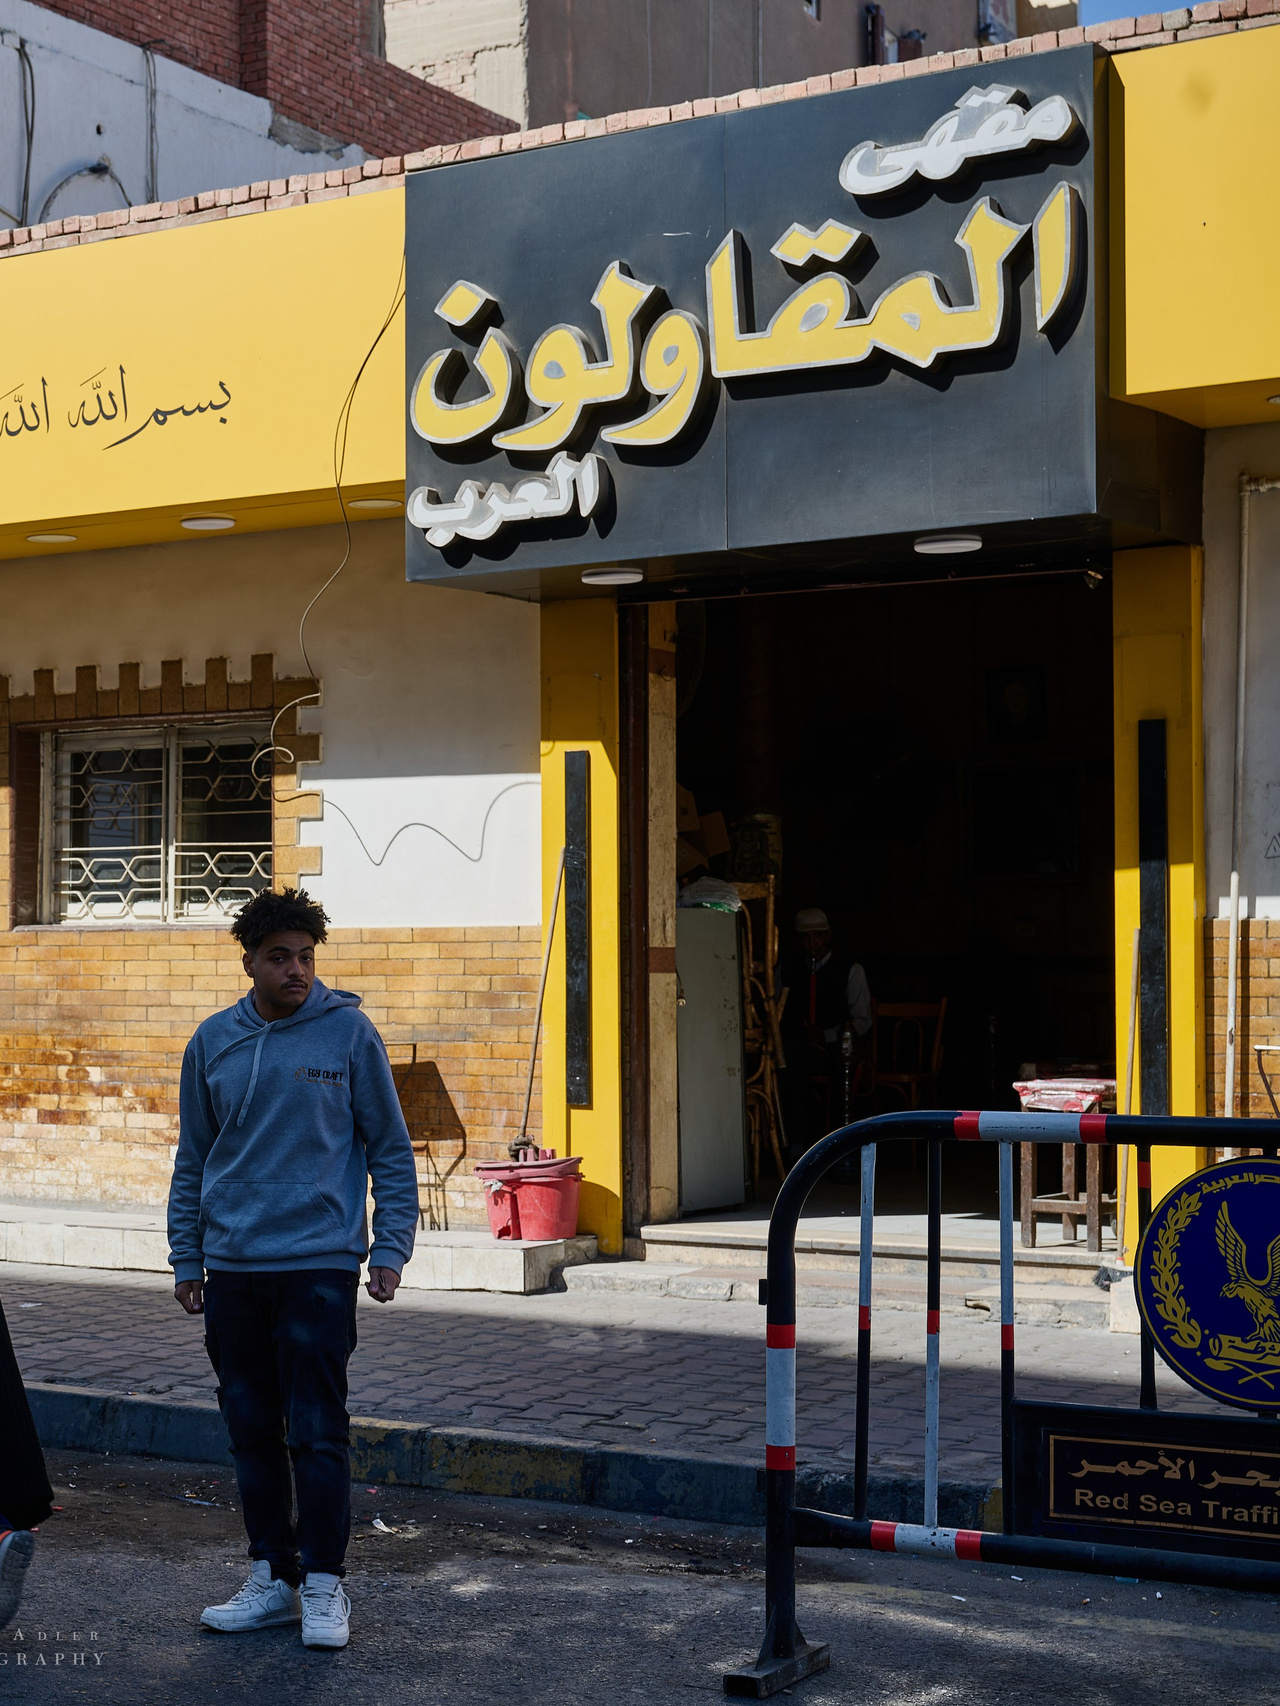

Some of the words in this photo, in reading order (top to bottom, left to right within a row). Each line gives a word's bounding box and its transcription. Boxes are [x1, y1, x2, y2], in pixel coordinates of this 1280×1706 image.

[839, 84, 1077, 197] مقهى
[408, 181, 1078, 452] المقاولون
[68, 365, 131, 427] الله
[102, 379, 232, 451] بسم
[407, 451, 602, 549] العرب
[1196, 1172, 1255, 1195] العربية
[1067, 1450, 1196, 1480] الأحمر
[1074, 1489, 1129, 1511] Red
[1139, 1494, 1192, 1516] Sea
[1201, 1499, 1280, 1525] Traffi
